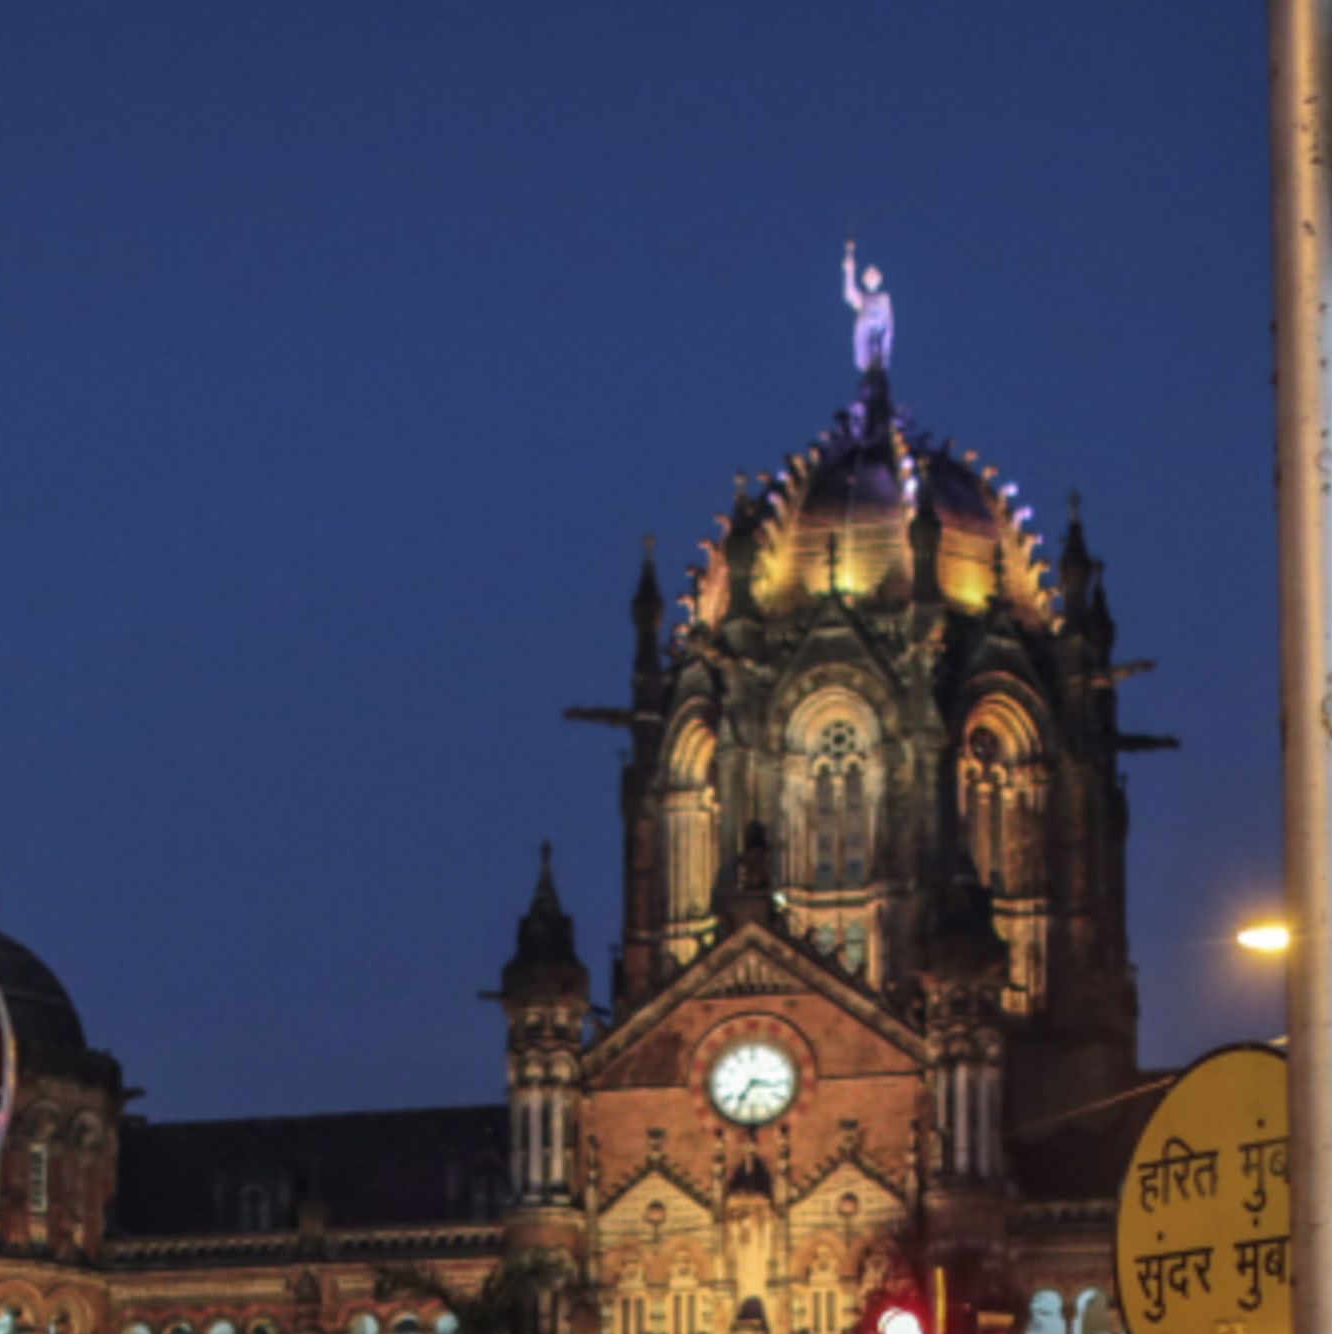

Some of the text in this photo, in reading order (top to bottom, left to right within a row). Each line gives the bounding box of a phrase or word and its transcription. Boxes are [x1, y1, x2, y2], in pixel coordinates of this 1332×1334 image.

[1137, 1118, 1291, 1213] हरित मुंब
[1134, 1217, 1294, 1323] सुंदर मुंब
